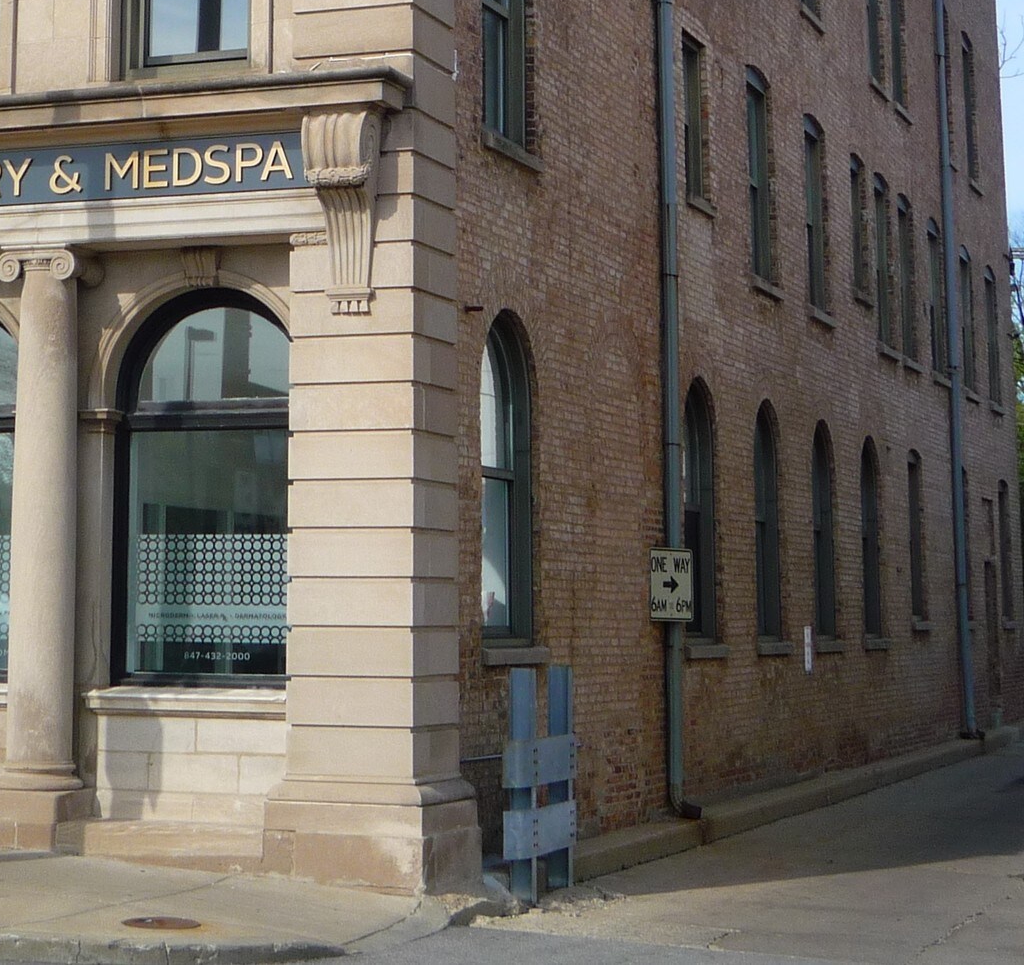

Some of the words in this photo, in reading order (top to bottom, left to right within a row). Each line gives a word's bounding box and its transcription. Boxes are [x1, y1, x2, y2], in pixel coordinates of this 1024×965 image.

[49, 155, 82, 194] &
[105, 140, 294, 191] MEDSPA
[650, 556, 668, 573] ONE
[673, 557, 691, 574] WAY
[184, 651, 251, 661] 847-432-2000
